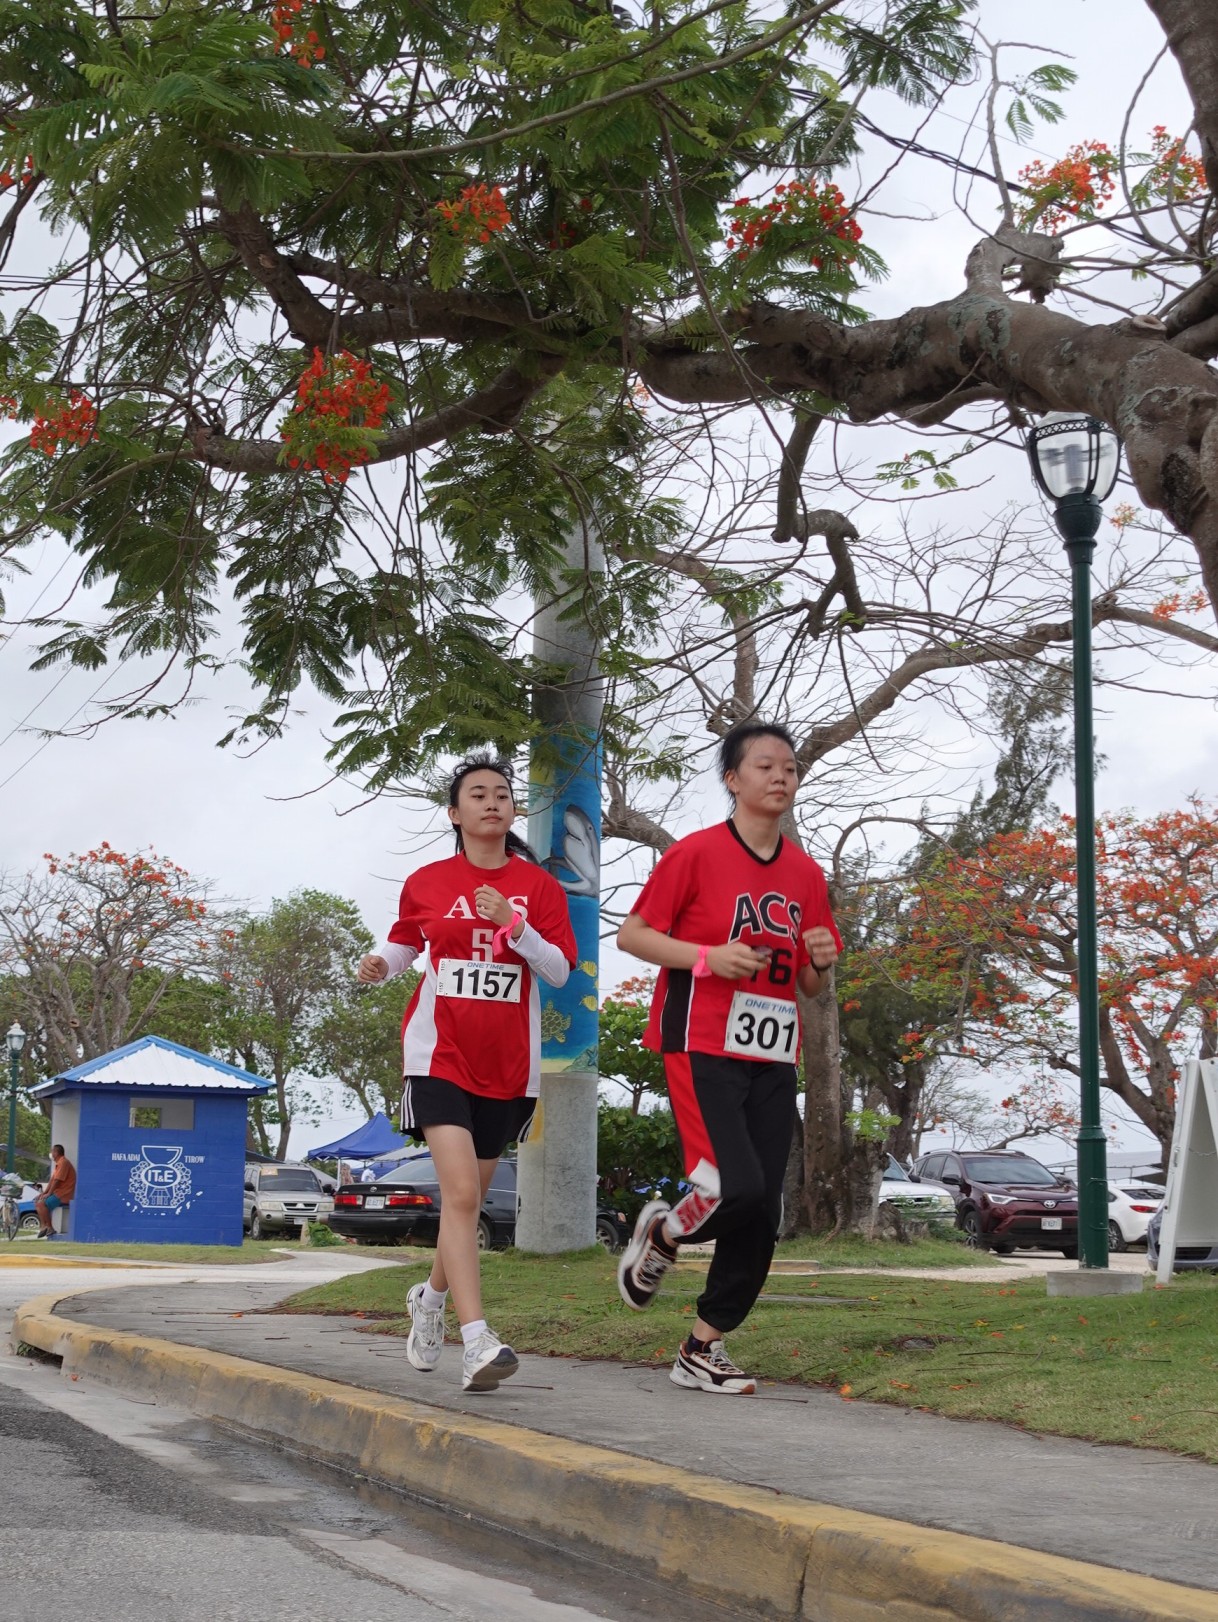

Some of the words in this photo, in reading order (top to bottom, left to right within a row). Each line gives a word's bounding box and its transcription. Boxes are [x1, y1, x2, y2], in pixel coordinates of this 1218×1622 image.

[443, 895, 528, 920] AS
[452, 968, 518, 998] 1157
[734, 1012, 796, 1053] 301
[147, 1169, 174, 1183] IT&E
